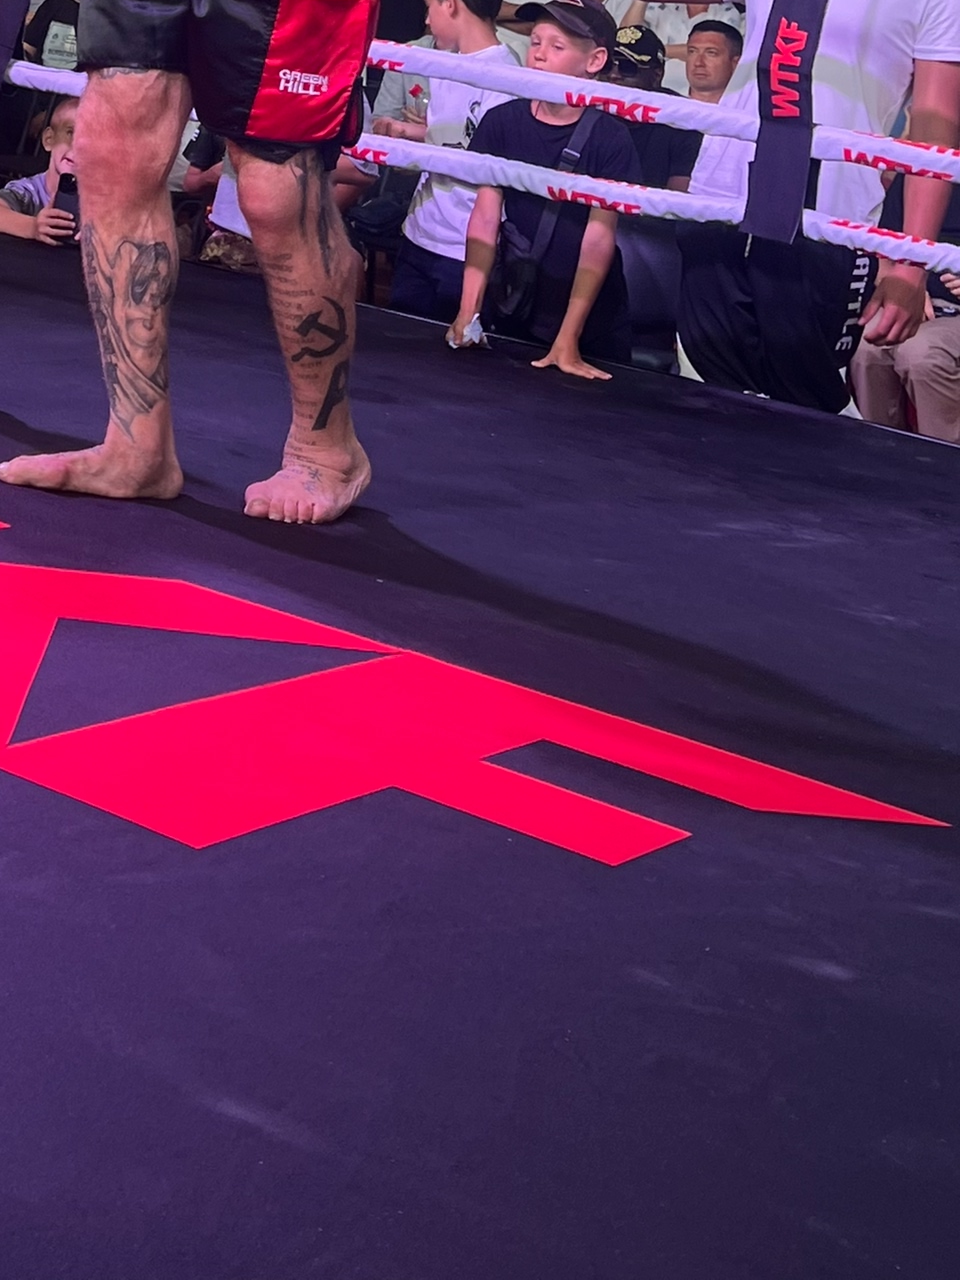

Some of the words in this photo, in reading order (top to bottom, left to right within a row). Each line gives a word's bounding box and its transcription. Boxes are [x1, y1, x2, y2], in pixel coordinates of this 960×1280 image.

[279, 69, 328, 85] GREEN
[770, 16, 809, 117] WTKF
[279, 79, 321, 96] HILL
[565, 91, 662, 123] WTKF
[835, 248, 871, 352] ATTLE
